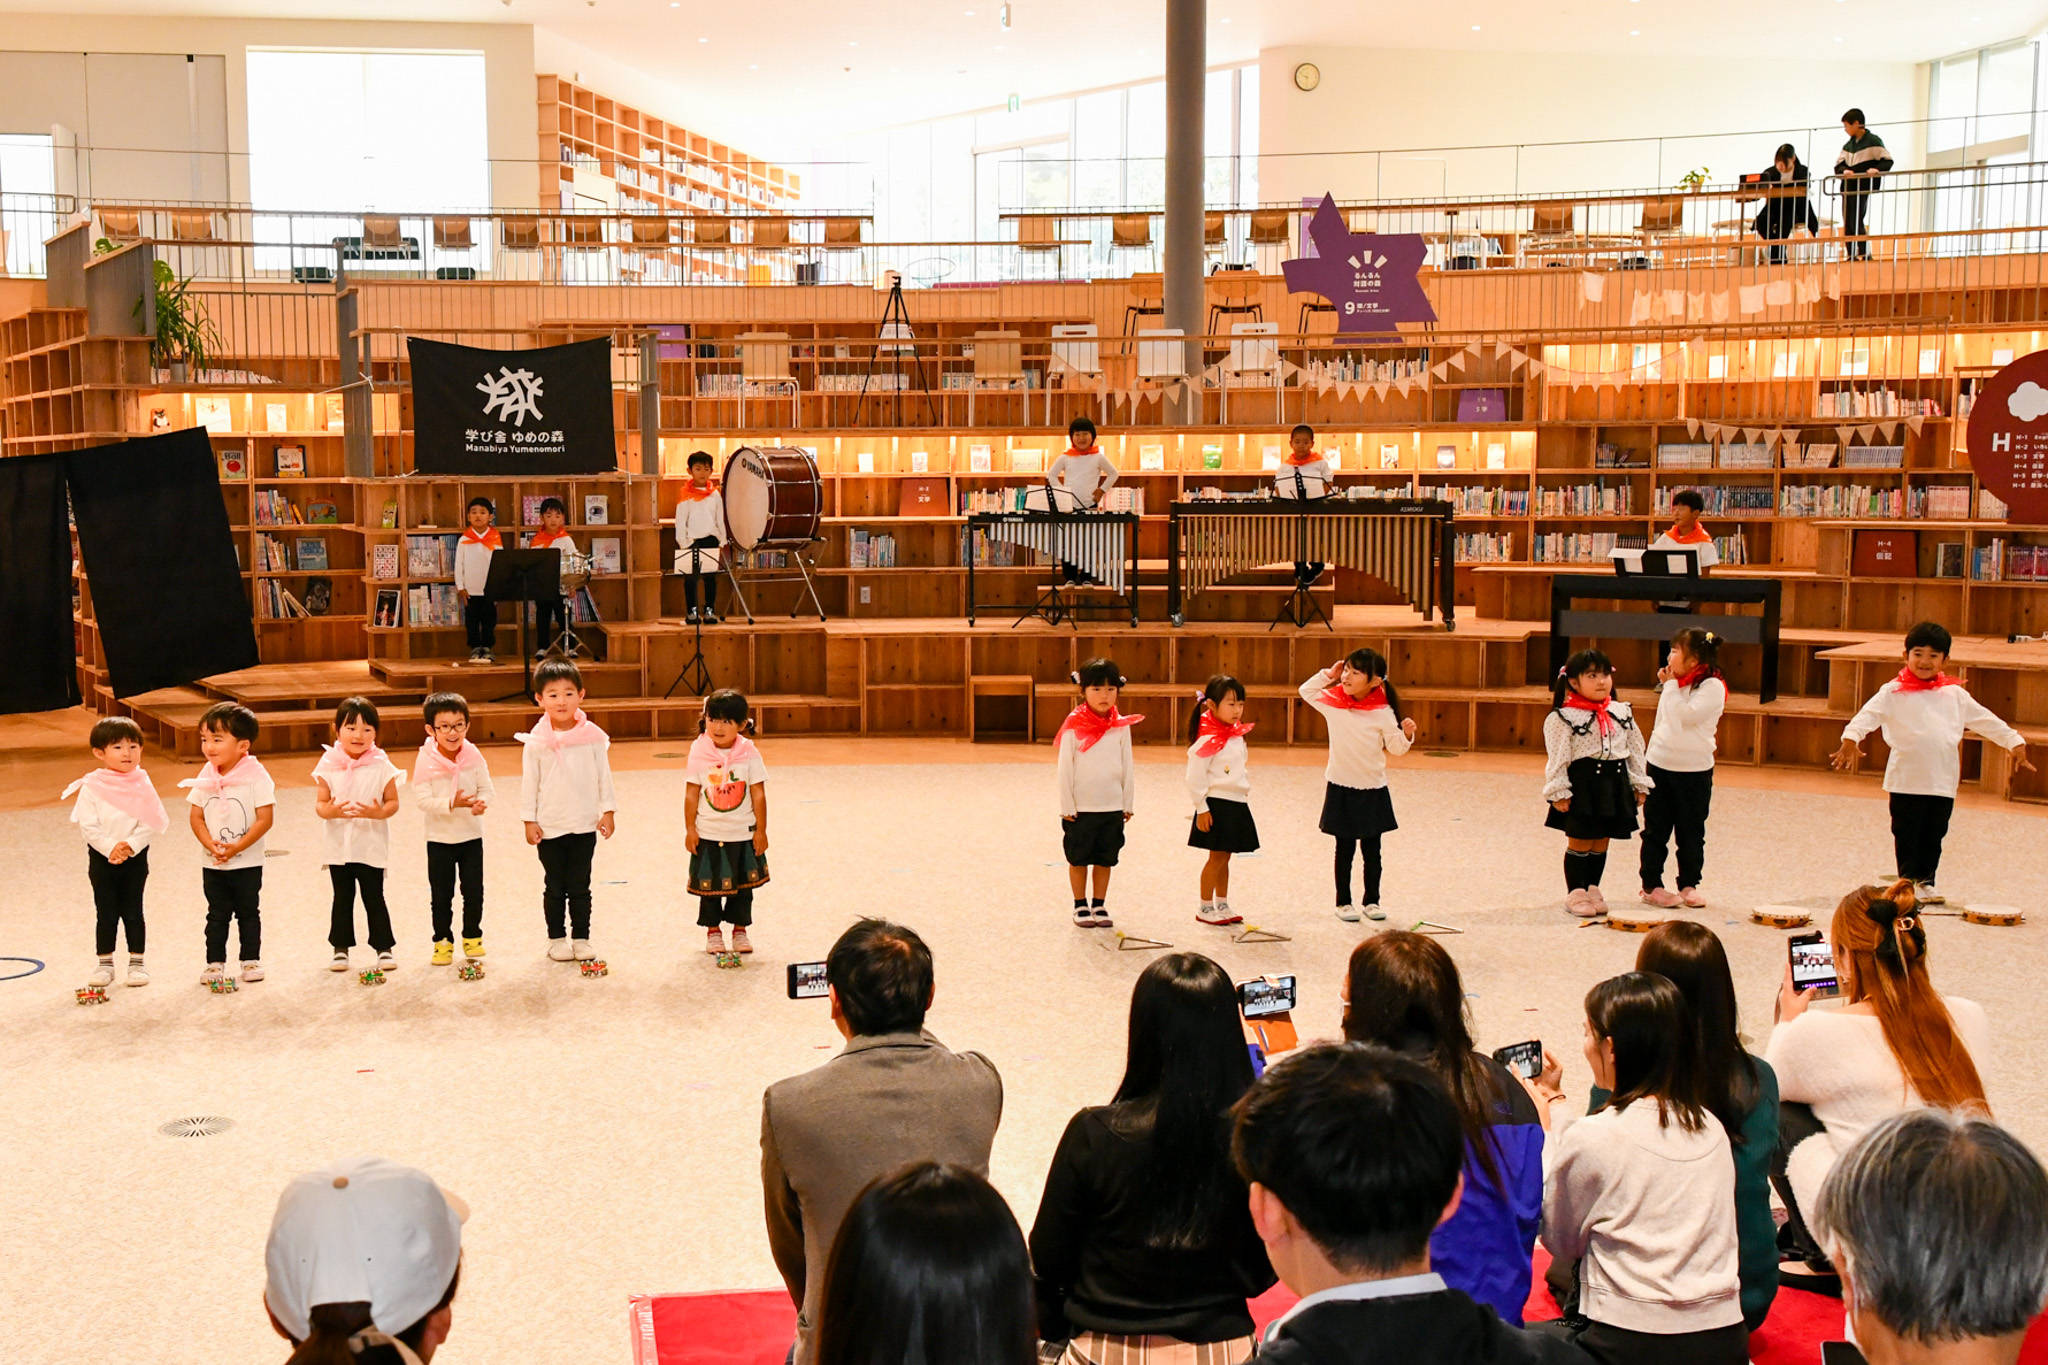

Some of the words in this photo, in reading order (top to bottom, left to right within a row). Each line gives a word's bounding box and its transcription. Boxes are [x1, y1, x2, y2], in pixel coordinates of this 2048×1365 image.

[1344, 301, 1355, 315] 9
[465, 428, 507, 443] 学び舎
[511, 429, 564, 443] ゆめの森
[1992, 432, 2011, 452] H
[465, 443, 508, 454] Manabiya
[509, 445, 565, 454] Yumenomori
[746, 460, 764, 479] YAMAHA
